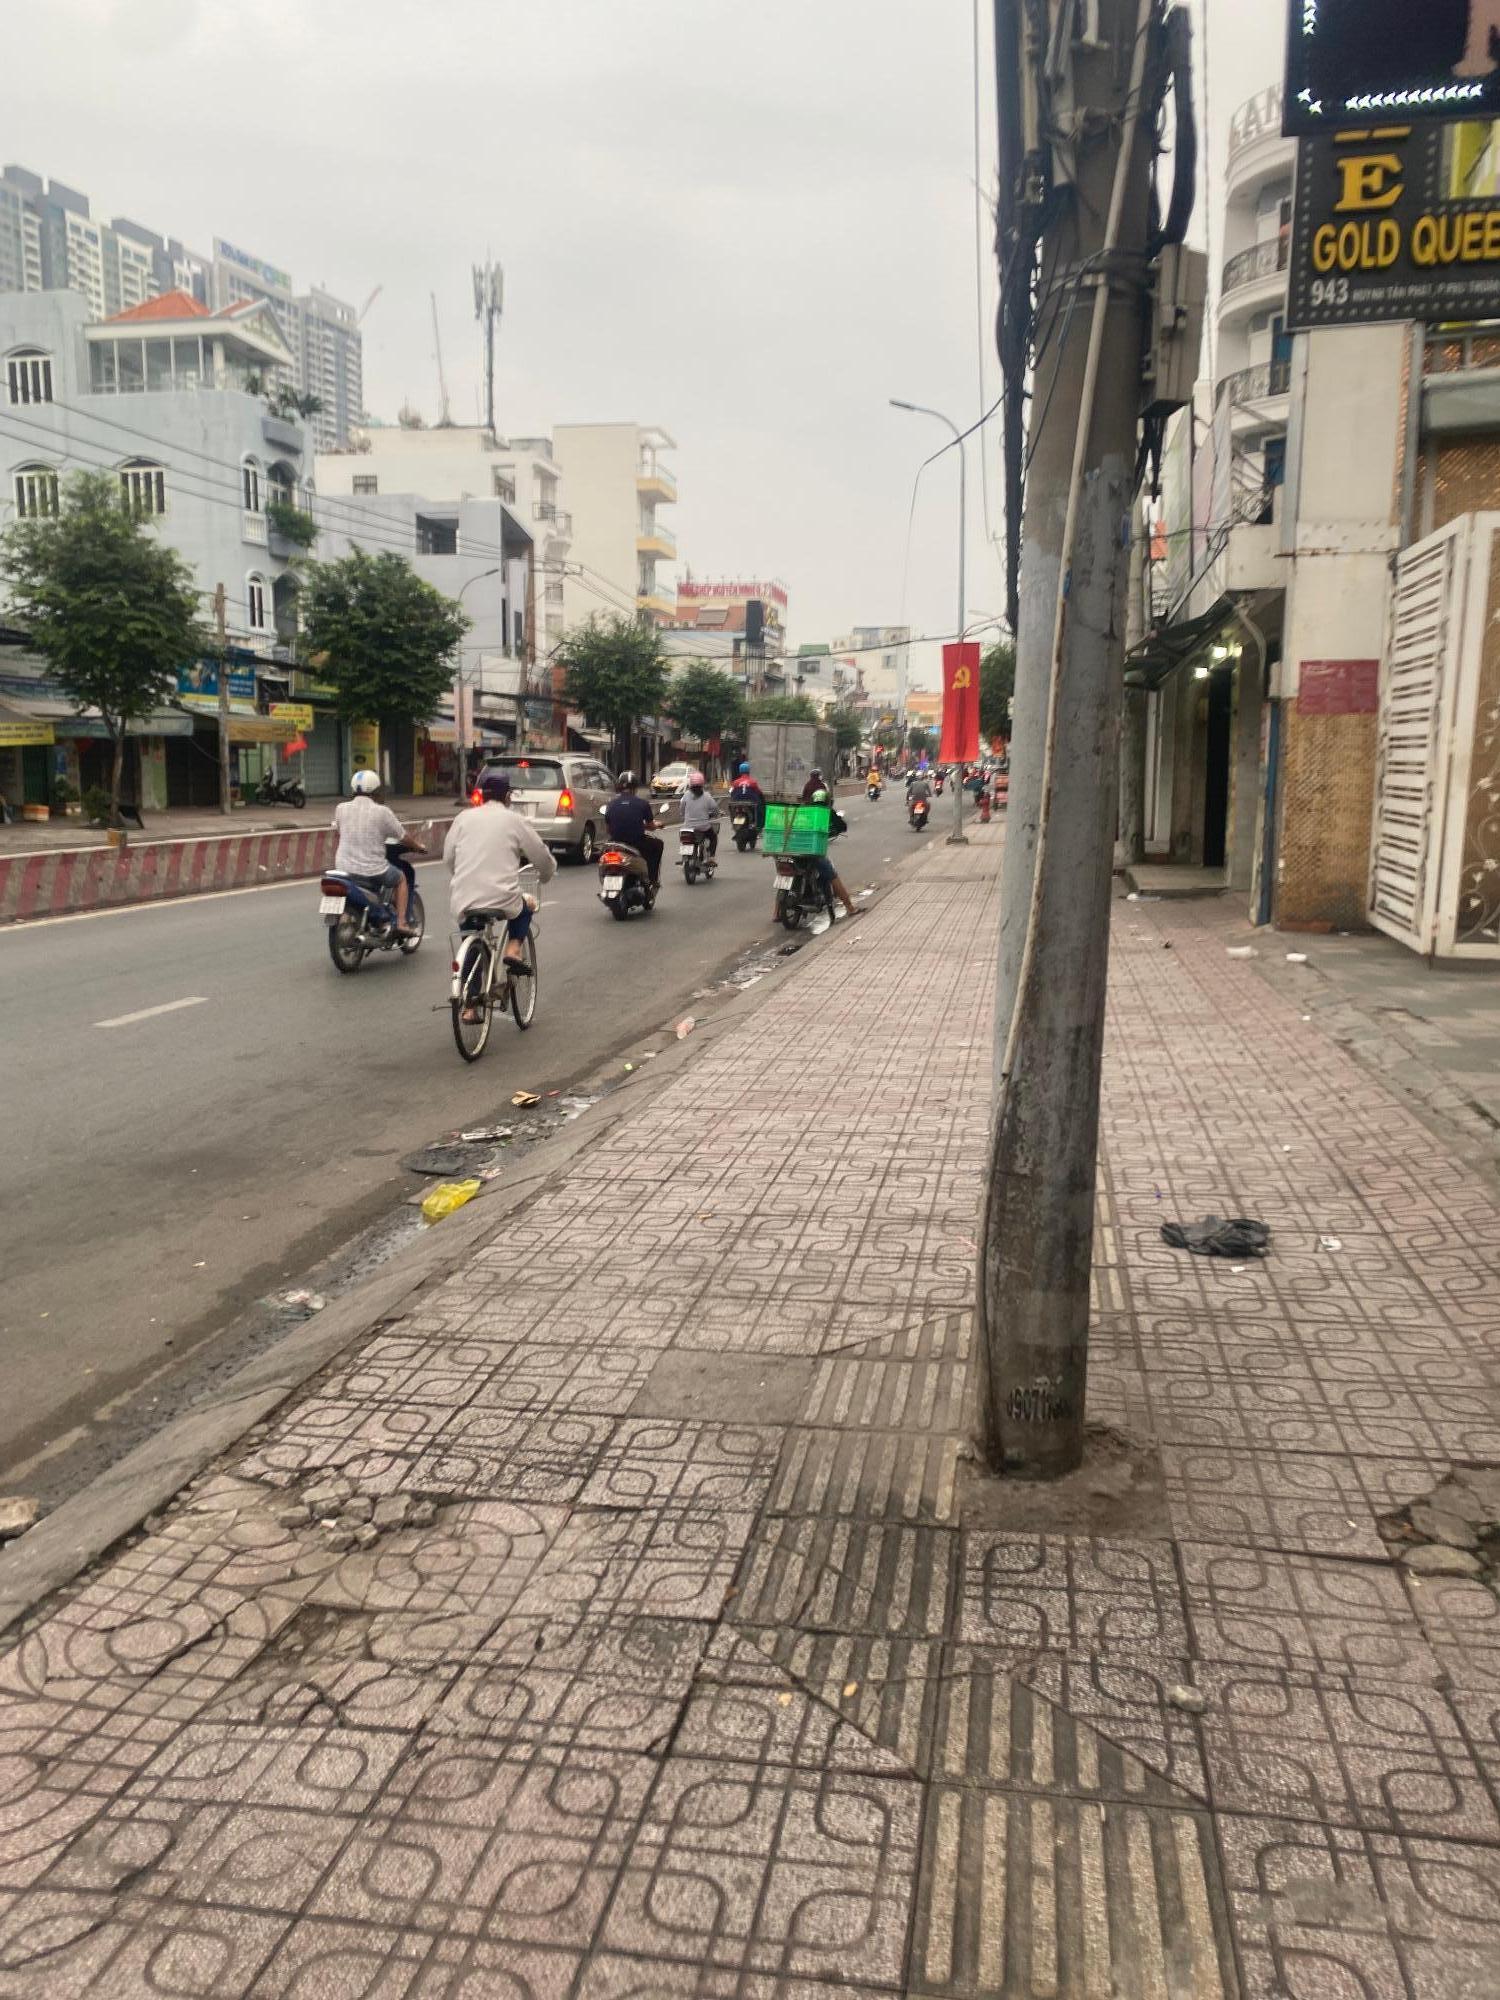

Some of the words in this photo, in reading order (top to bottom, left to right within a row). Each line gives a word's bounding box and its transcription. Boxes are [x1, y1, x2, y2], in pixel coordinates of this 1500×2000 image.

[1313, 218, 1400, 272] GOLD
[1412, 211, 1500, 265] QUEE
[1311, 277, 1349, 306] 943
